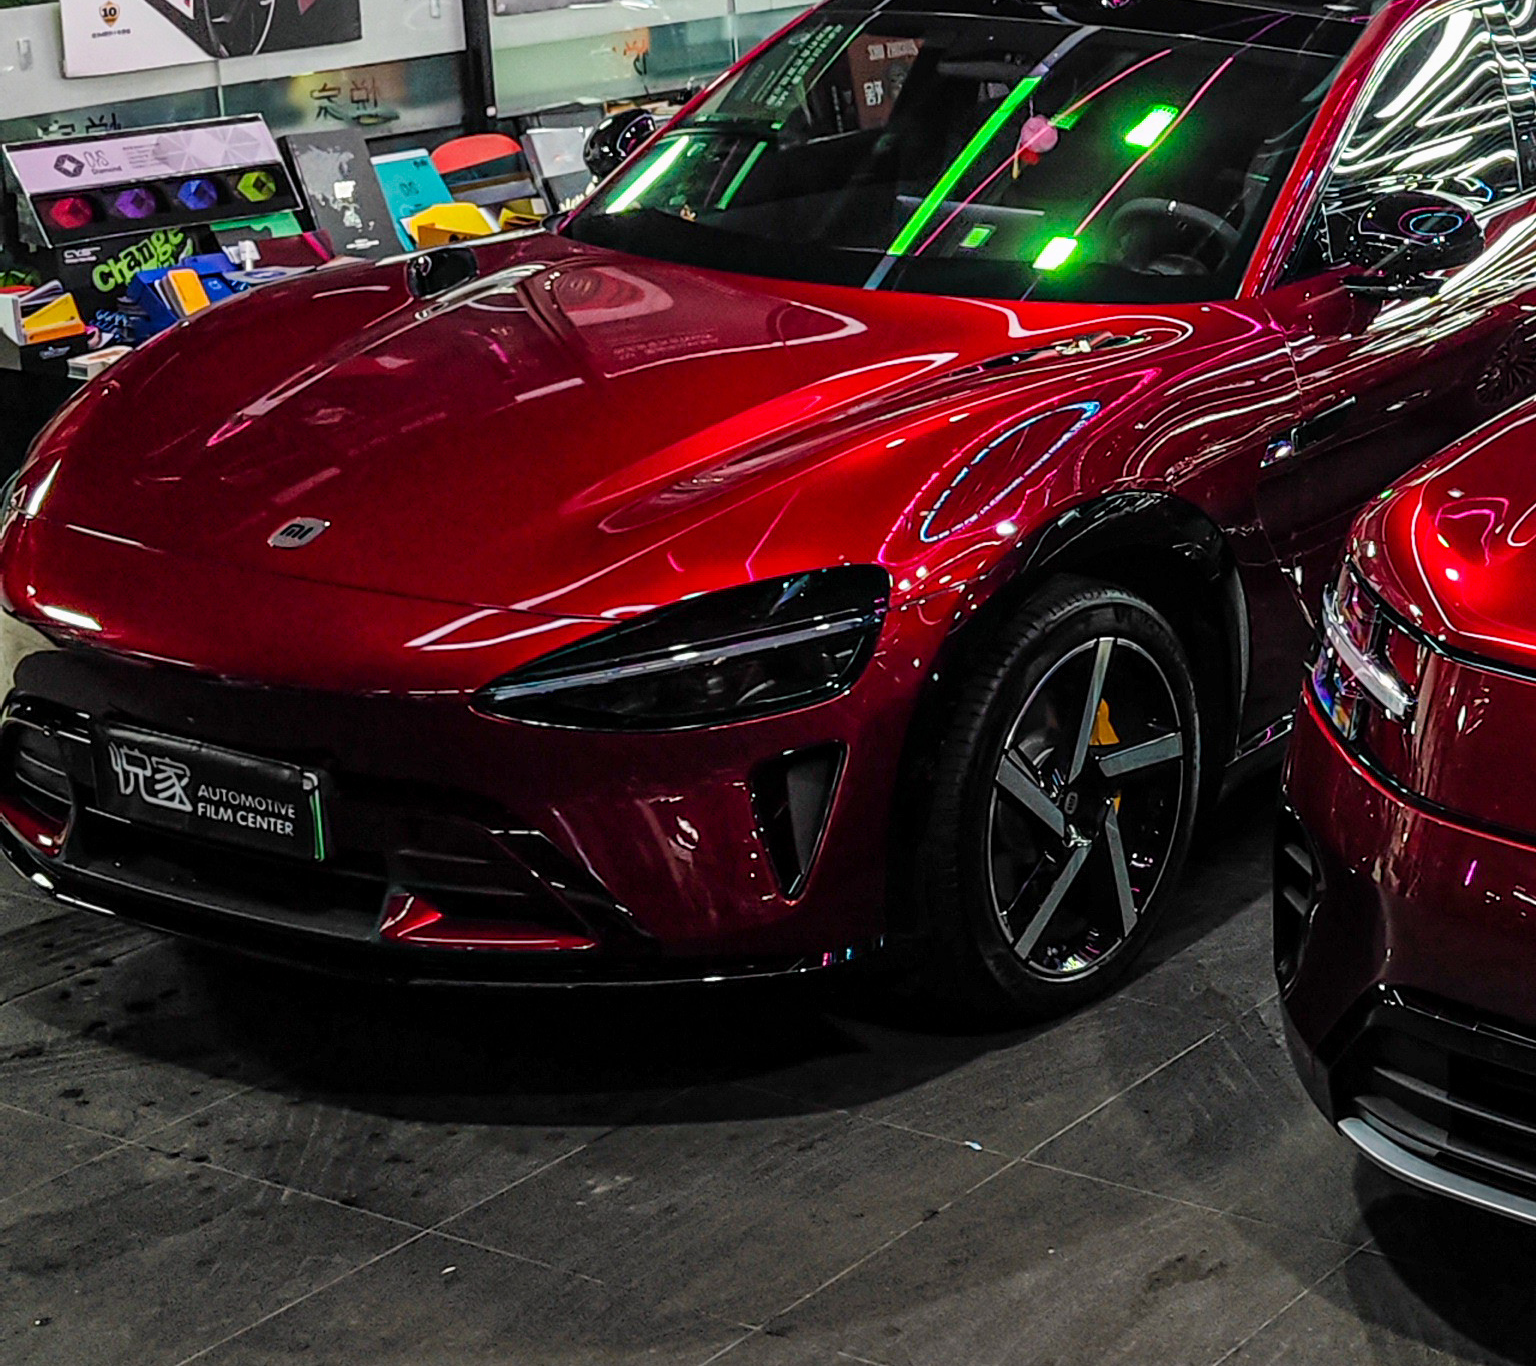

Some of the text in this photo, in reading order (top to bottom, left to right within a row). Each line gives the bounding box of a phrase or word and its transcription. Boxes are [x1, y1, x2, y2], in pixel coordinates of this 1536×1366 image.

[102, 6, 118, 18] 10
[109, 741, 193, 813] 悦家
[198, 784, 296, 819] AUTOMOTIVE
[198, 802, 294, 837] FILM CENTER
